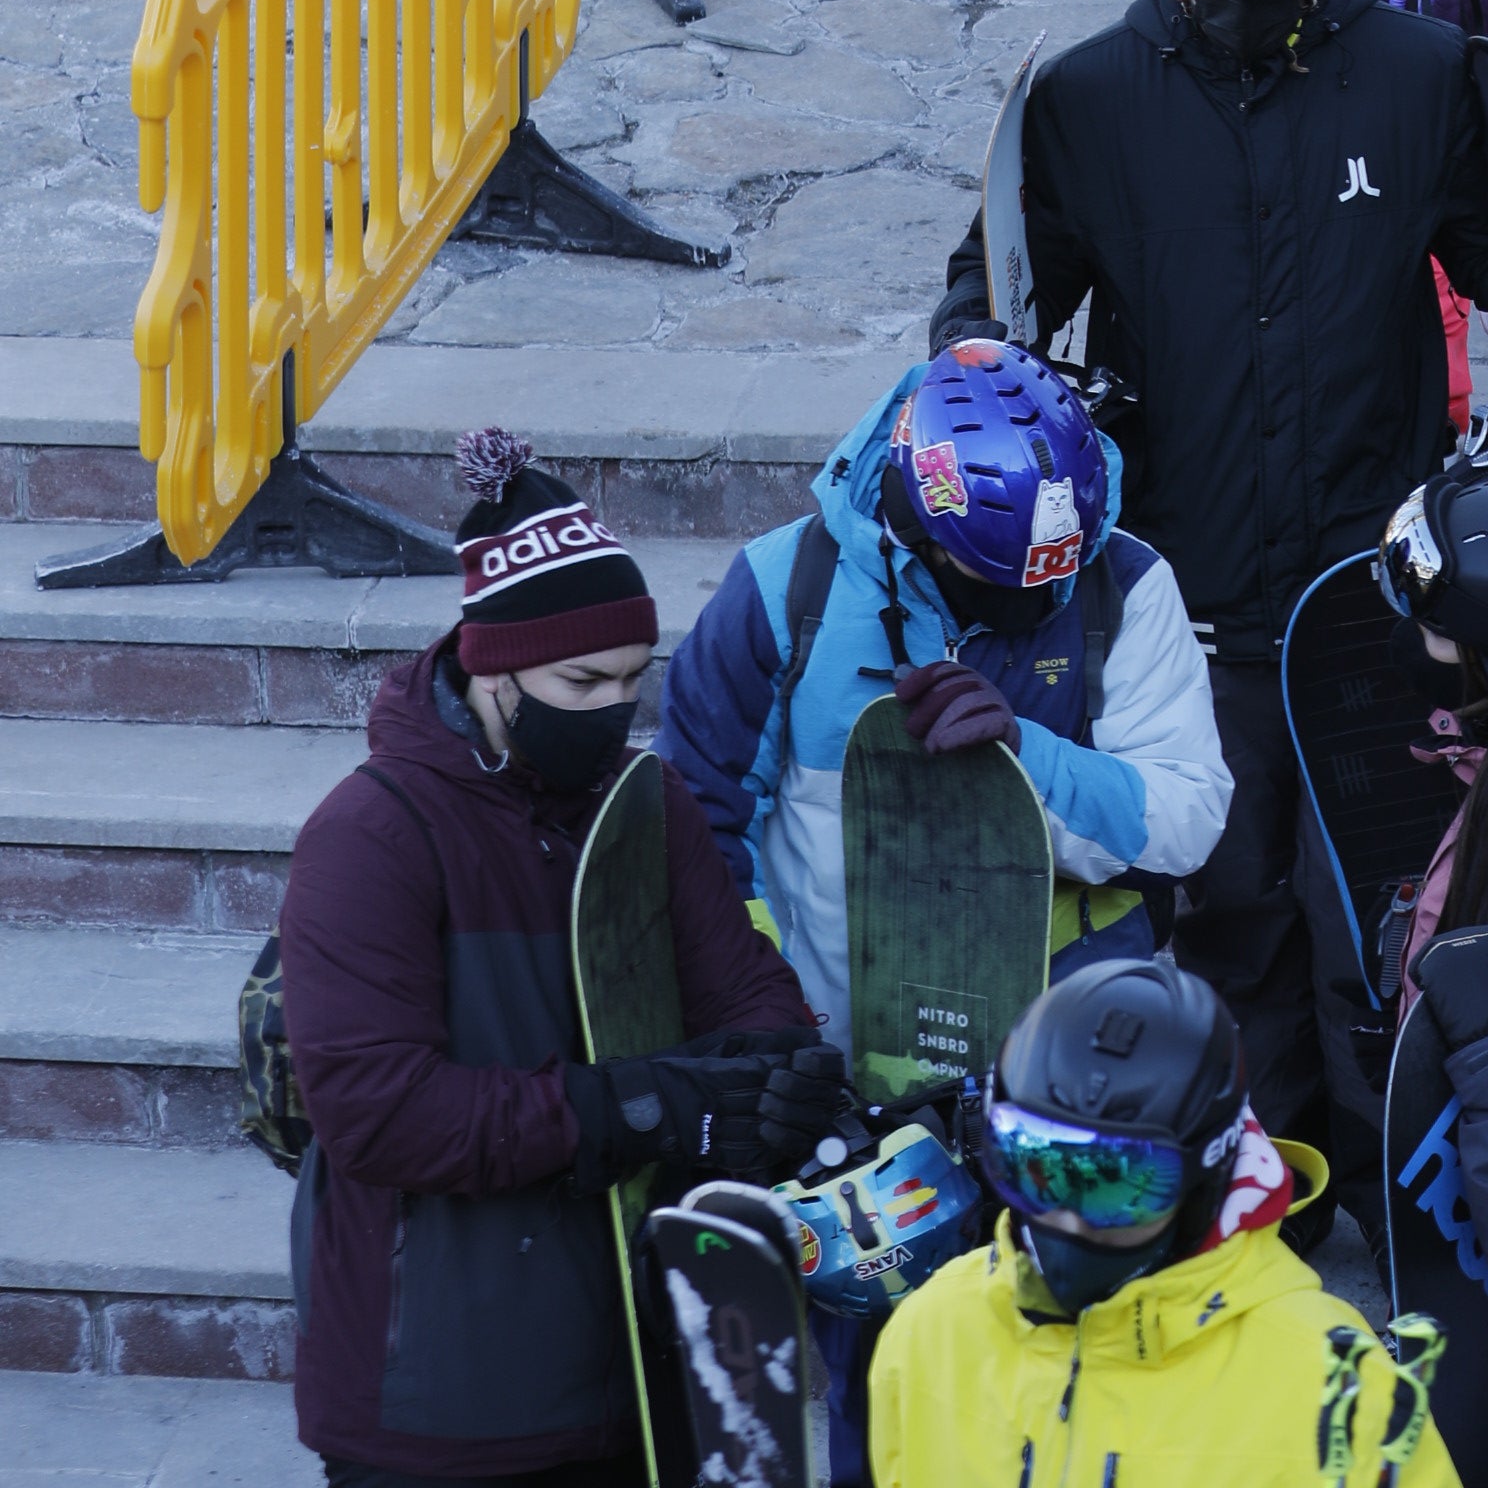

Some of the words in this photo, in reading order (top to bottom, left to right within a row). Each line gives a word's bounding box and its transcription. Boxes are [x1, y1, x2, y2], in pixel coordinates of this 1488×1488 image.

[1022, 529, 1084, 588] DC
[1034, 657, 1069, 669] SNOW
[918, 1006, 969, 1028] NITRO
[918, 1032, 969, 1054] SNBRD
[917, 1058, 969, 1078] CMPNY
[854, 1246, 914, 1281] VANS
